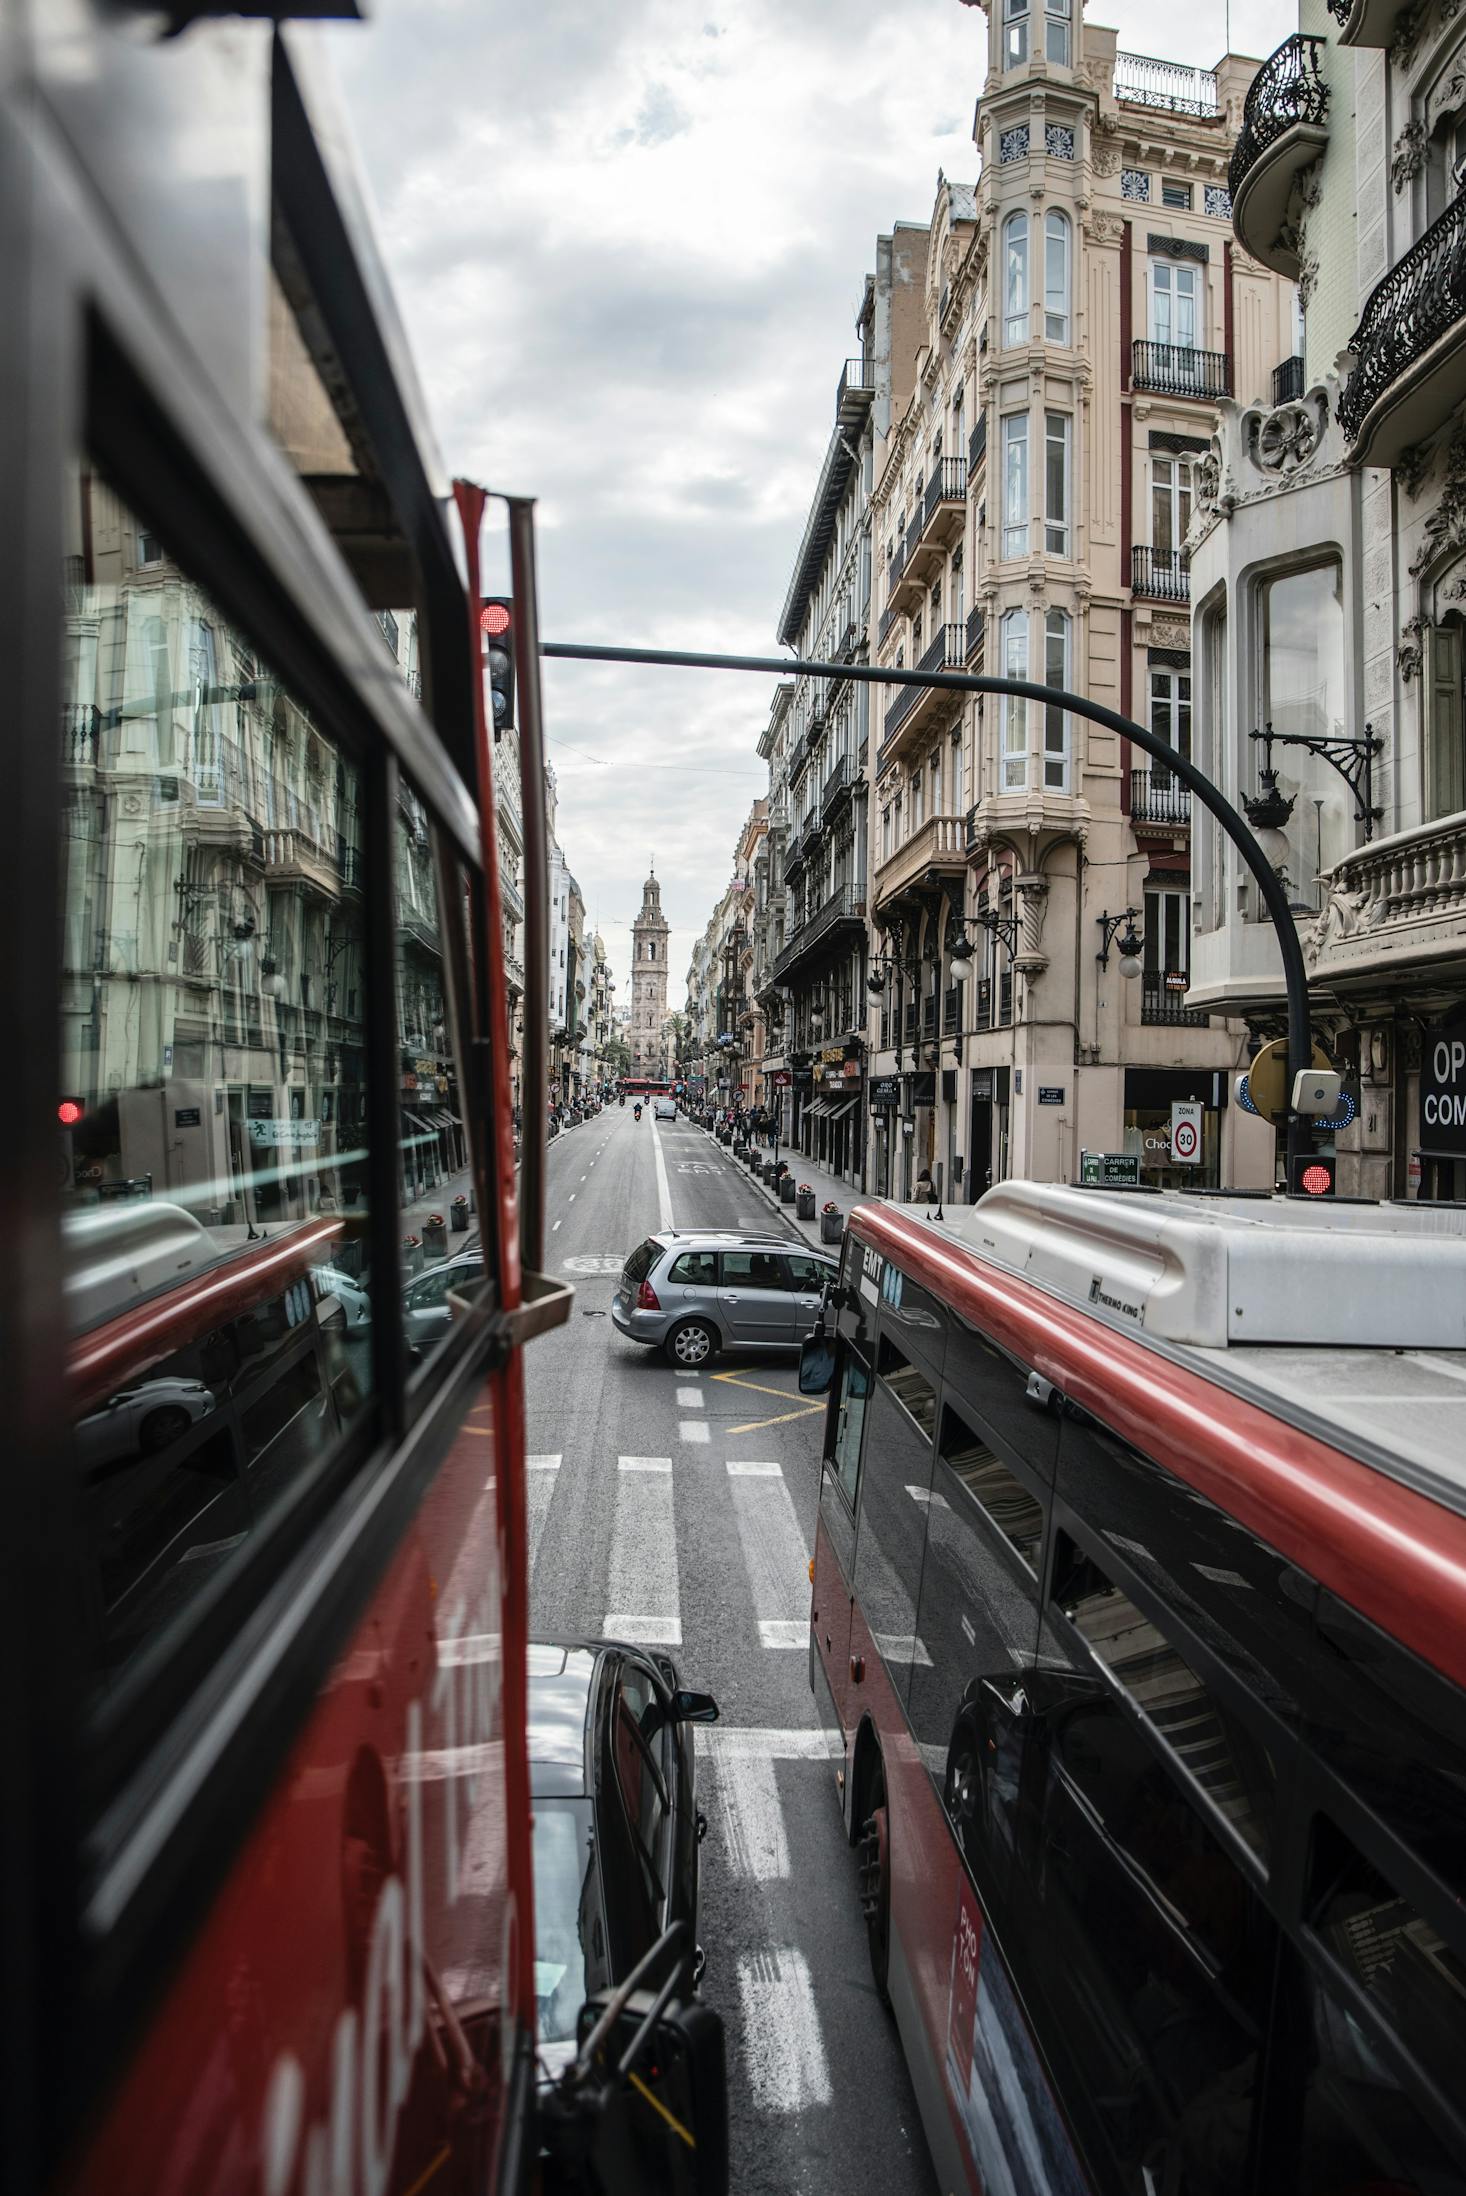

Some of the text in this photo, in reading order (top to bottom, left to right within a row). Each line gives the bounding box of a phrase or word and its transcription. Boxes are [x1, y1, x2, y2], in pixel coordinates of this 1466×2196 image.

[1178, 1107, 1195, 1115] ZONA
[1180, 1134, 1193, 1145] 30
[862, 1245, 884, 1282] EMT
